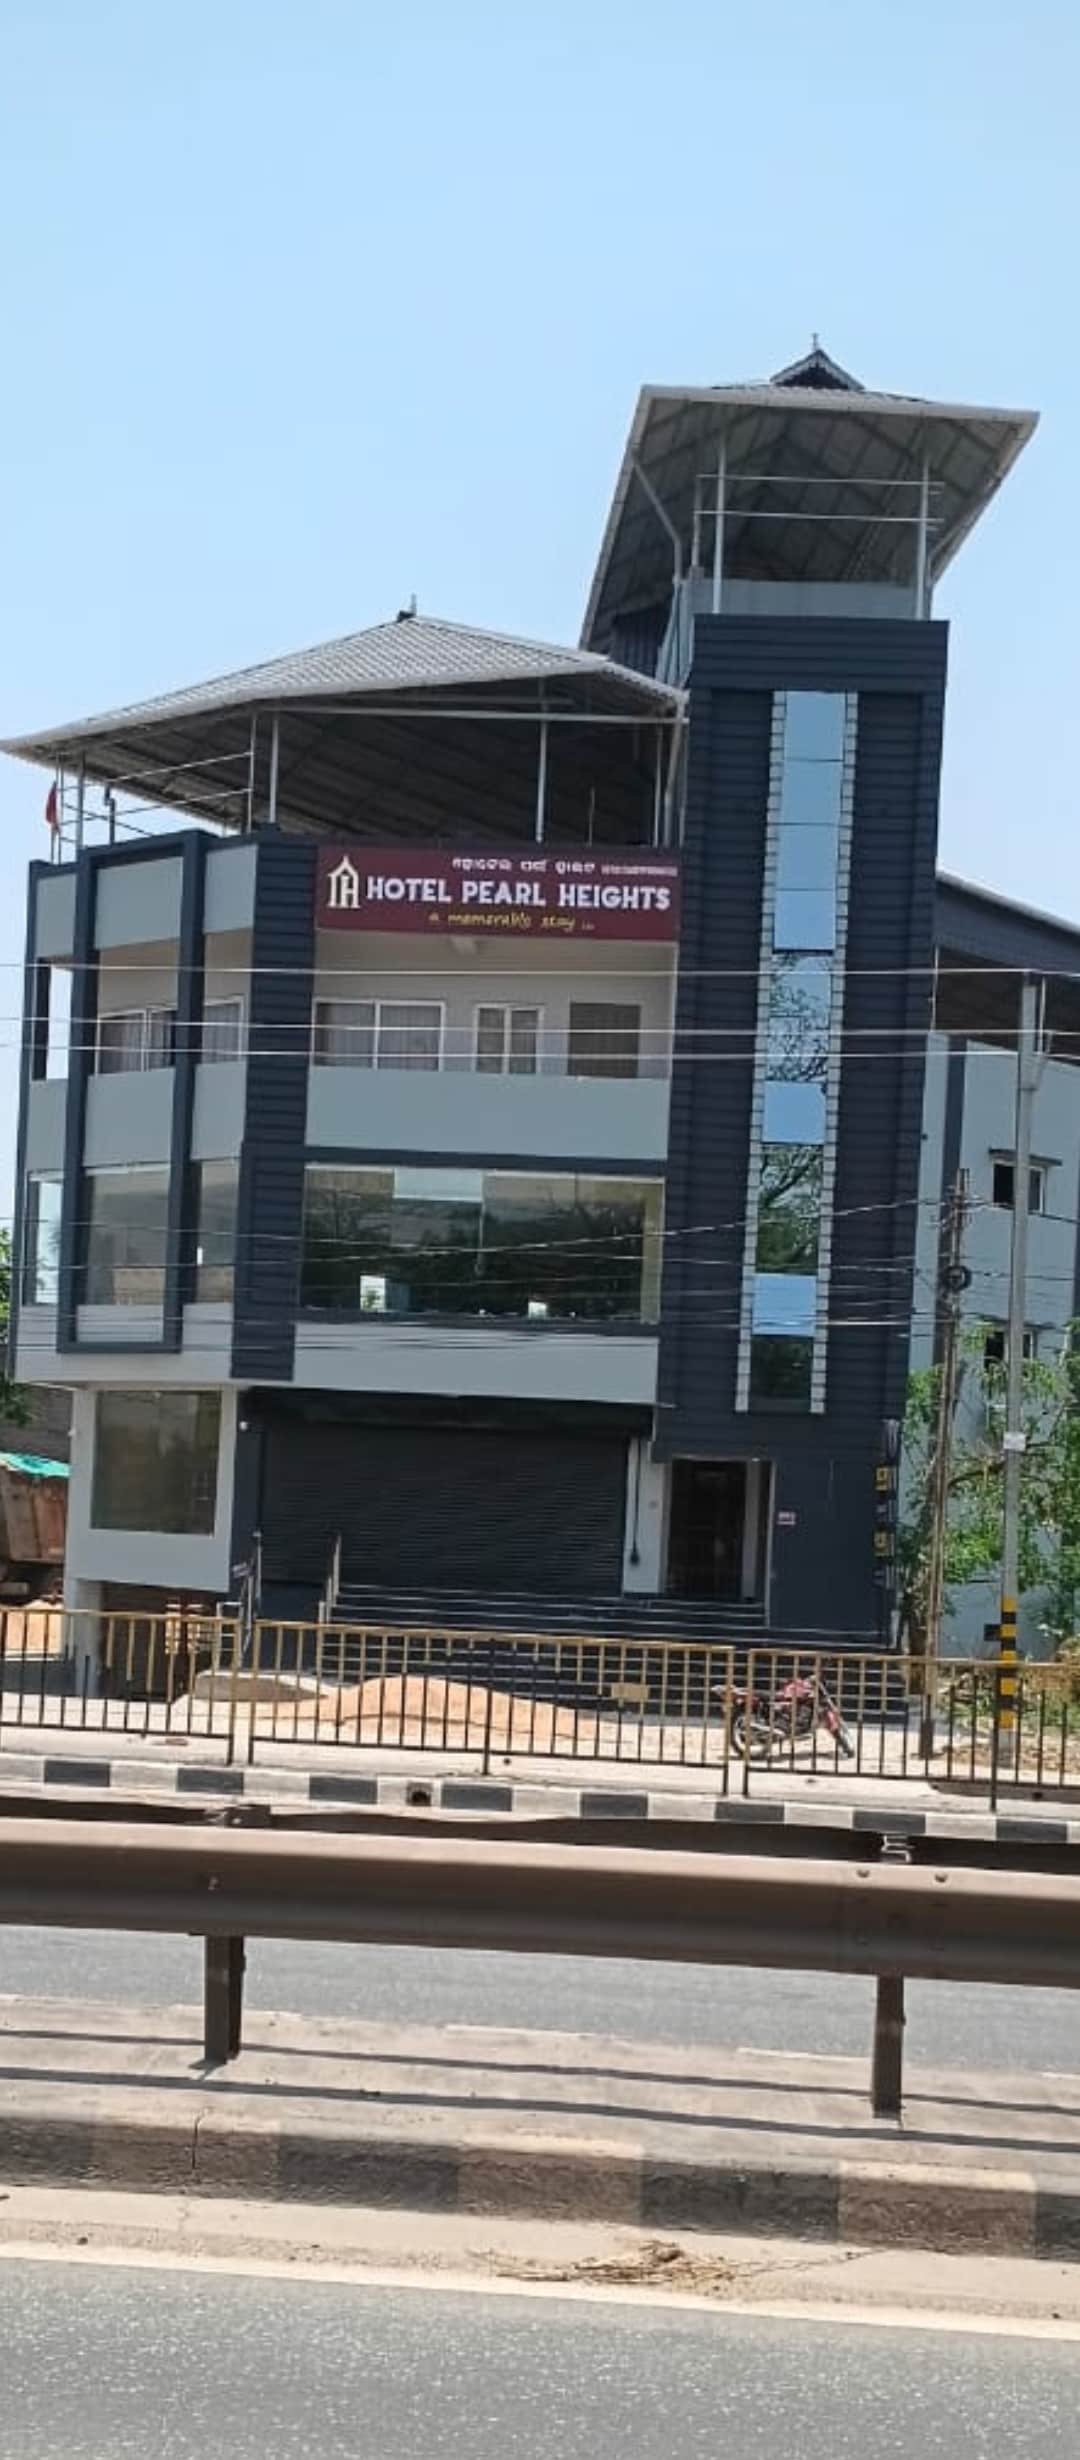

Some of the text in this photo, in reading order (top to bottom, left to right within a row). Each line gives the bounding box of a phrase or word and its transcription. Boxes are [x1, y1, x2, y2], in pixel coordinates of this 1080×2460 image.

[366, 876, 671, 910] HOTEL PEARL HEIGHTS
